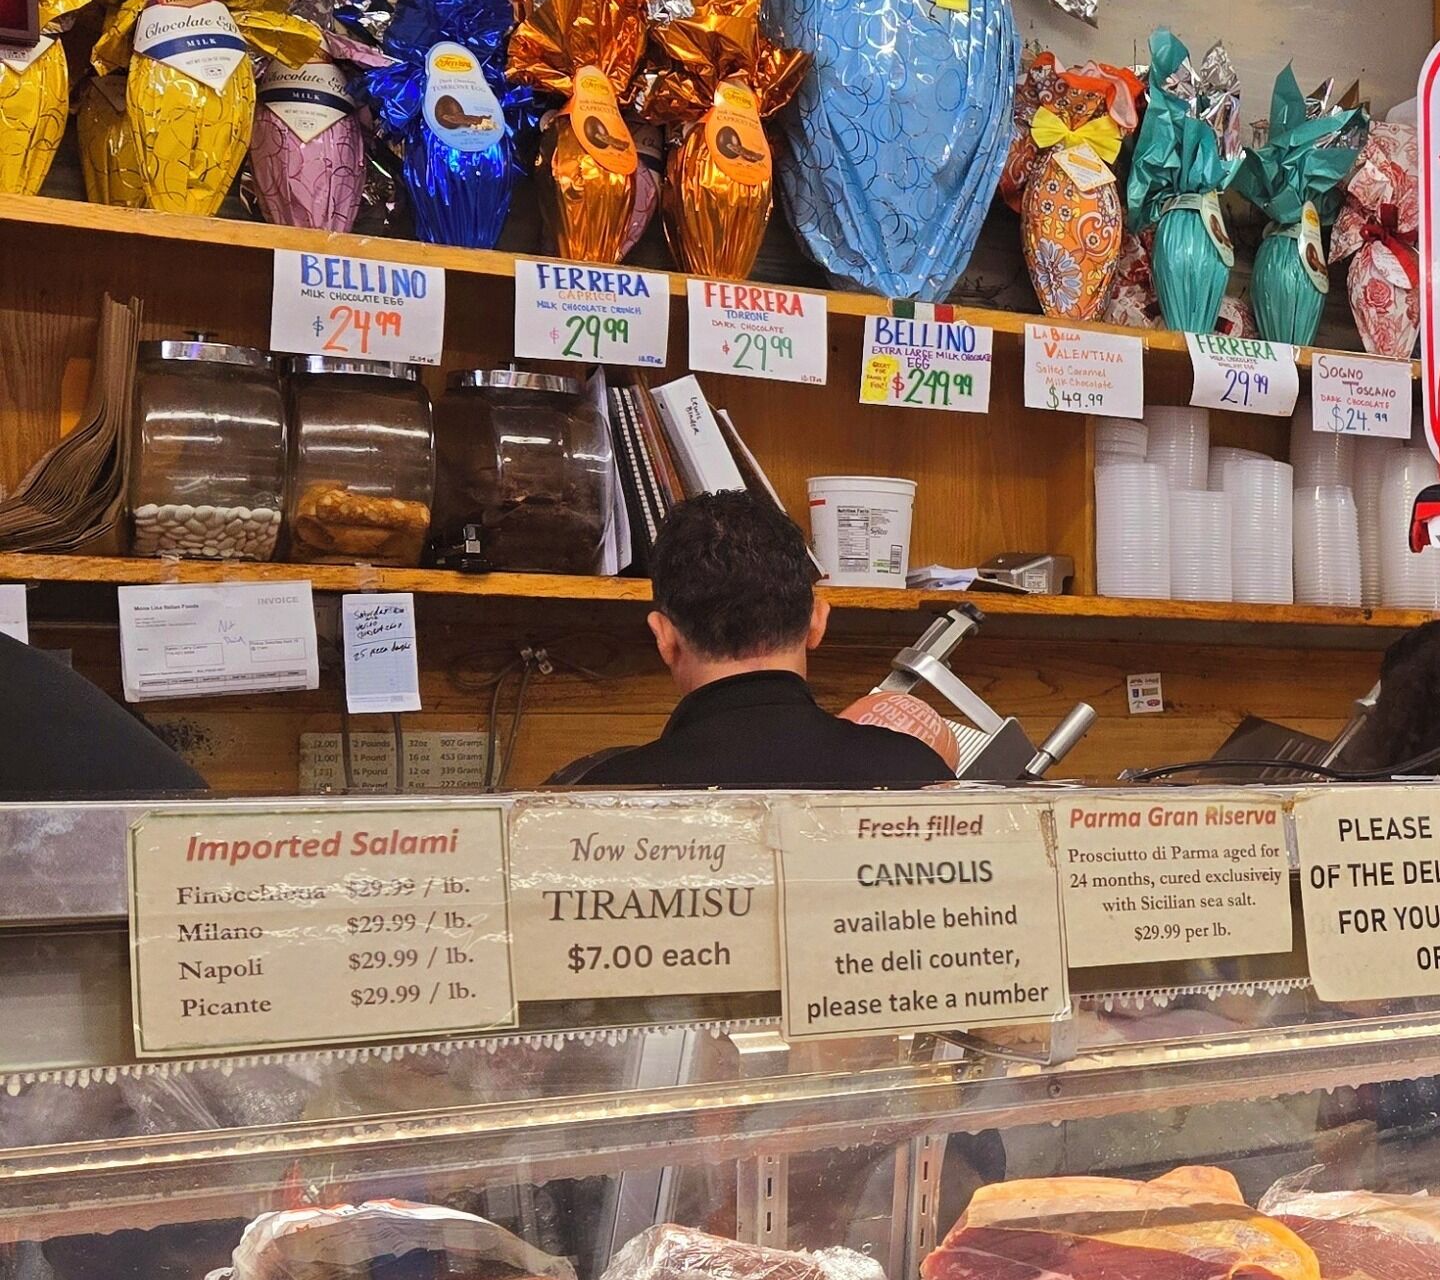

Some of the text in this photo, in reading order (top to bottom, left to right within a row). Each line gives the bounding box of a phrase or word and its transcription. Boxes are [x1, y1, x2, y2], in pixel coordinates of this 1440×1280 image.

[145, 14, 238, 39] Chocolate Egg
[186, 36, 217, 48] MILK
[301, 254, 428, 300] BELLINO
[537, 263, 652, 299] FERRERA
[704, 281, 804, 319] FERRERA
[873, 314, 976, 354] BELLINO
[1195, 332, 1278, 363] FERRERA
[1043, 340, 1124, 365] VALENTINA
[1318, 354, 1363, 382] SOGNO
[1046, 384, 1104, 410] $49.99
[1347, 380, 1397, 400] TOSCANO
[257, 594, 301, 608] INVOICE
[857, 814, 985, 841] Fresh filled
[1069, 807, 1142, 830] Parma
[1147, 806, 1199, 828] Gran
[1338, 815, 1434, 842] PLEASE
[186, 828, 460, 866] Imported Salami
[569, 837, 727, 872] Now Serving
[855, 858, 994, 888] CANNOLIS
[1310, 863, 1342, 890] OF
[1349, 860, 1396, 888] THE
[542, 886, 756, 925] TIRAMISU
[832, 904, 1018, 936] available behind
[1338, 907, 1387, 935] FOR
[178, 942, 475, 985] Napoli $29.99 / lb.
[566, 942, 732, 974] $7.00 each
[835, 946, 1021, 976] the deli counter,
[806, 982, 1049, 1024] please take a number
